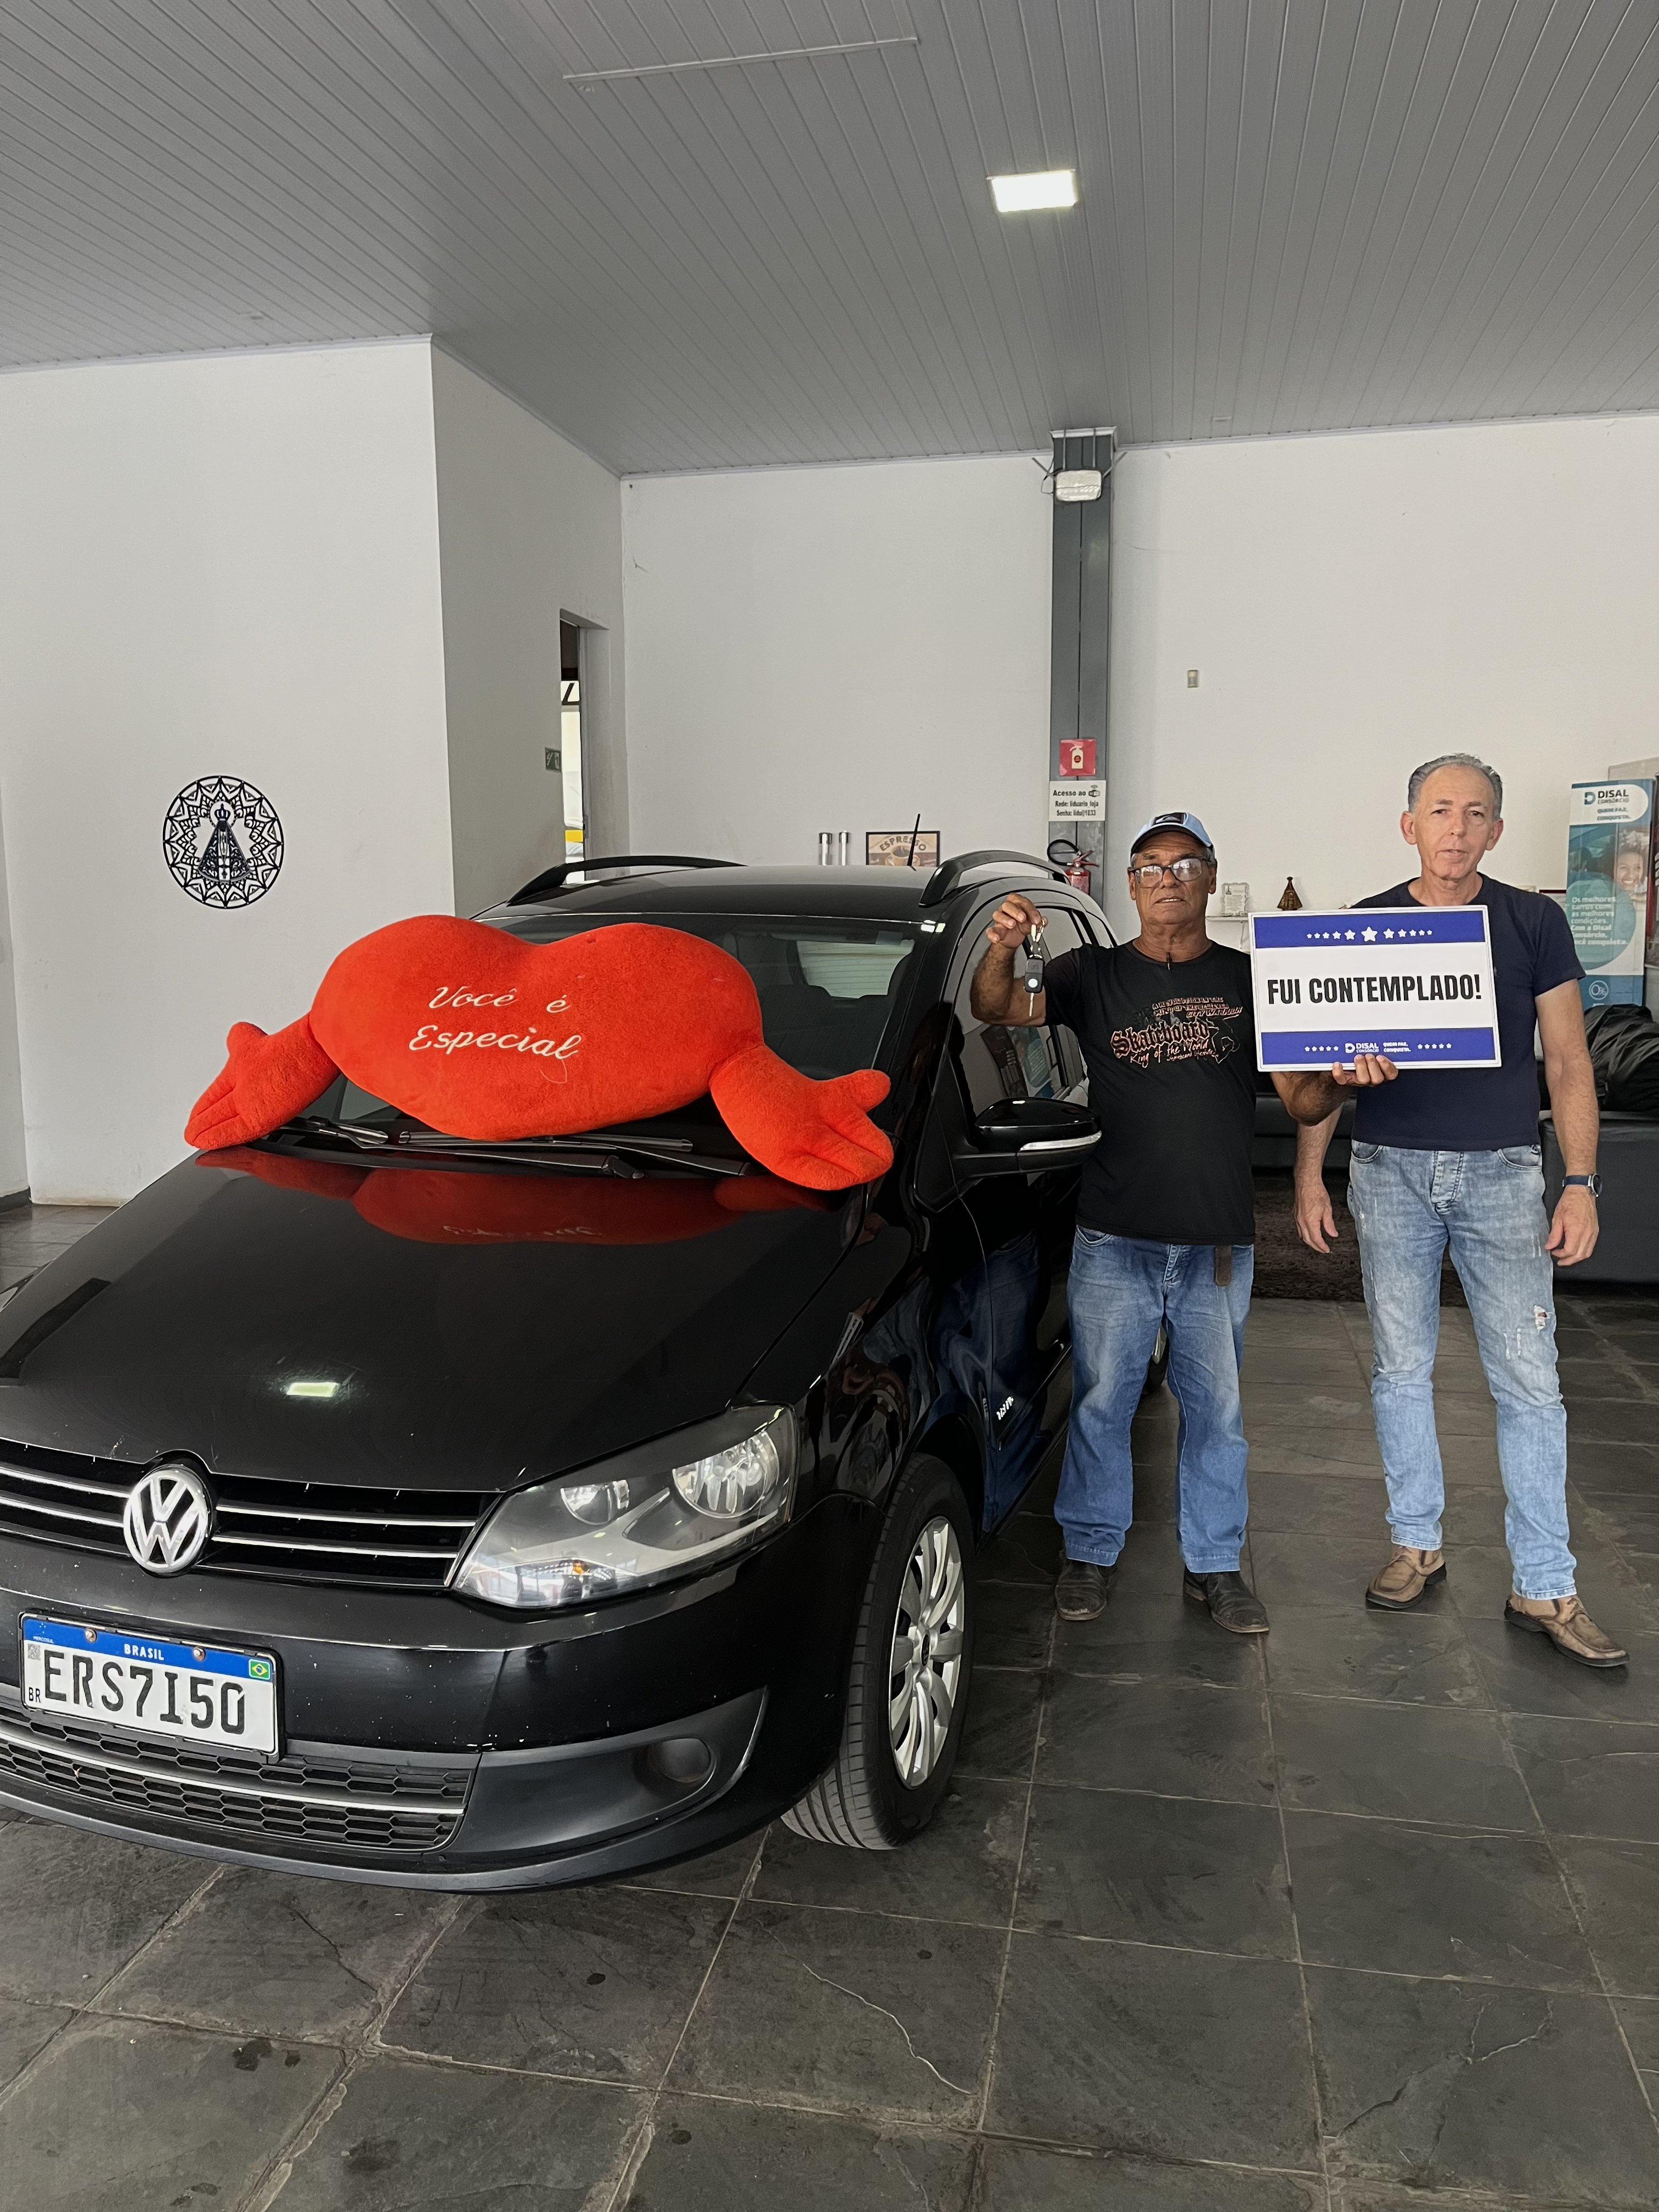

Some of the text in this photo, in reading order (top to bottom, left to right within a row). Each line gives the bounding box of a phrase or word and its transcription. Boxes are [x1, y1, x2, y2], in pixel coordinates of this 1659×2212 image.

[1598, 789, 1629, 798] DISAL
[879, 836, 926, 851] ESPRESSO
[1267, 974, 1482, 1005] FUI CONTEMPLADO!
[428, 986, 571, 1013] Você é
[409, 1024, 582, 1059] Especial
[1154, 1046, 1163, 1063] of
[1166, 1044, 1180, 1057] the
[33, 1635, 54, 1644] MERCOSUL
[123, 1643, 165, 1661] BRASIL
[29, 1686, 41, 1703] BR
[44, 1649, 245, 1735] ERS7I50
